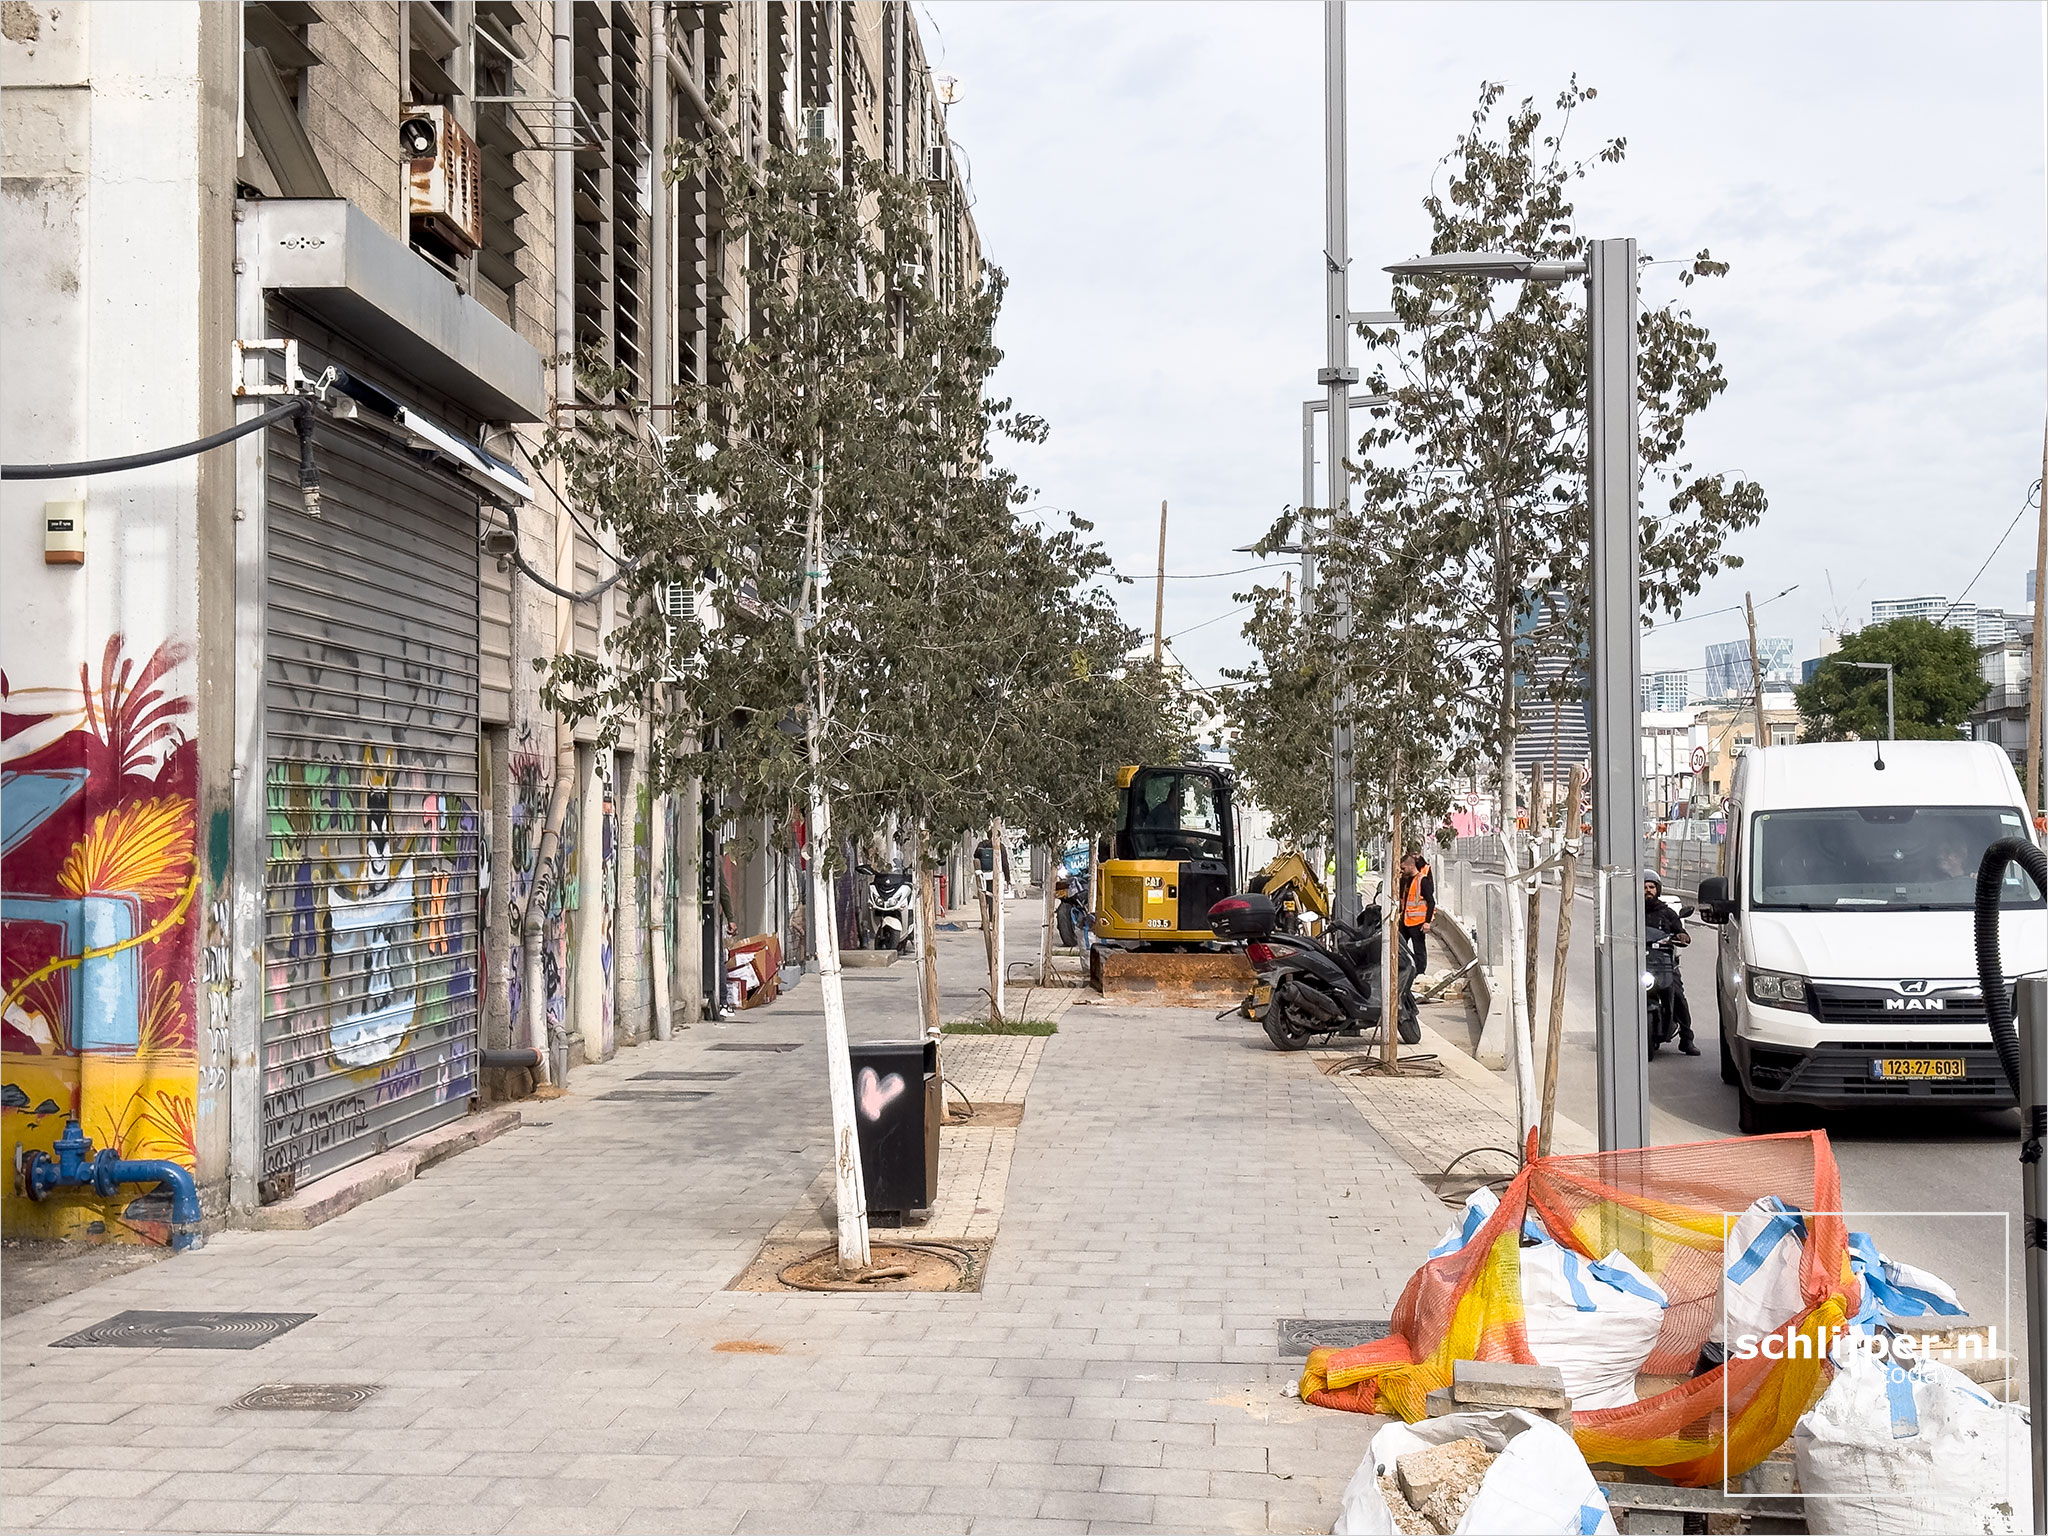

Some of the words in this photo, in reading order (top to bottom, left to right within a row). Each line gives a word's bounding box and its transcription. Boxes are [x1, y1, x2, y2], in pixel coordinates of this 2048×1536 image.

[1693, 754, 1704, 767] 30
[1144, 876, 1161, 887] CAT
[1147, 919, 1169, 928] 303.5
[202, 946, 230, 984] אוהב
[1885, 998, 1944, 1010] MAN
